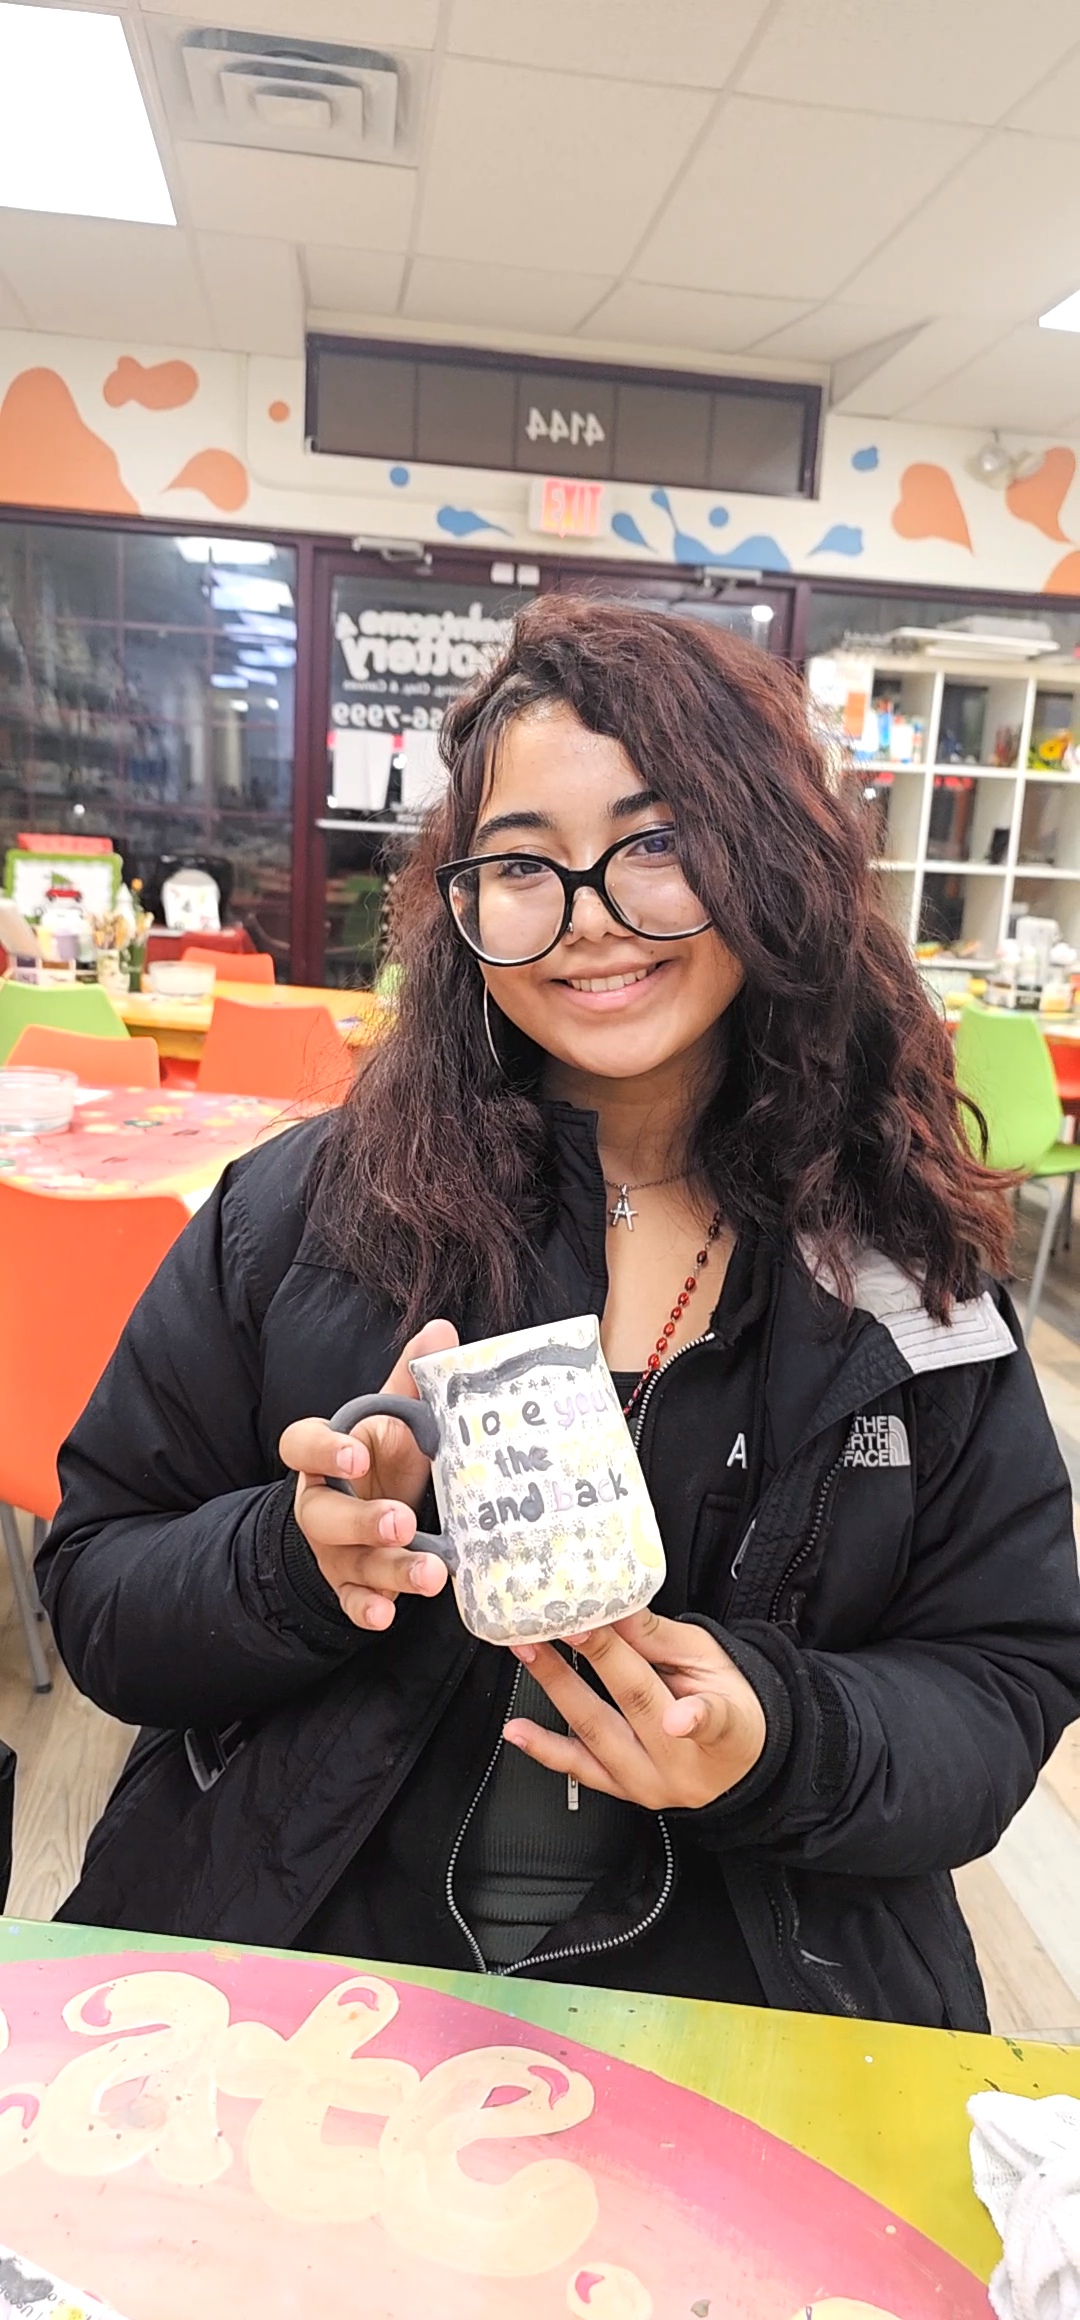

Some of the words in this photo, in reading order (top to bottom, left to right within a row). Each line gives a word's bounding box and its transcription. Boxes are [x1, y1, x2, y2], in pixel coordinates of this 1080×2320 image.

[541, 478, 604, 536] EXIT
[553, 1389, 608, 1430] you
[853, 1415, 888, 1432] THE
[726, 1432, 748, 1469] A
[843, 1450, 891, 1467] FACE
[849, 1433, 888, 1449] RTH
[494, 1445, 553, 1479] the
[478, 1482, 545, 1531] and
[551, 1467, 629, 1512] back
[0, 1970, 600, 2274] ate
